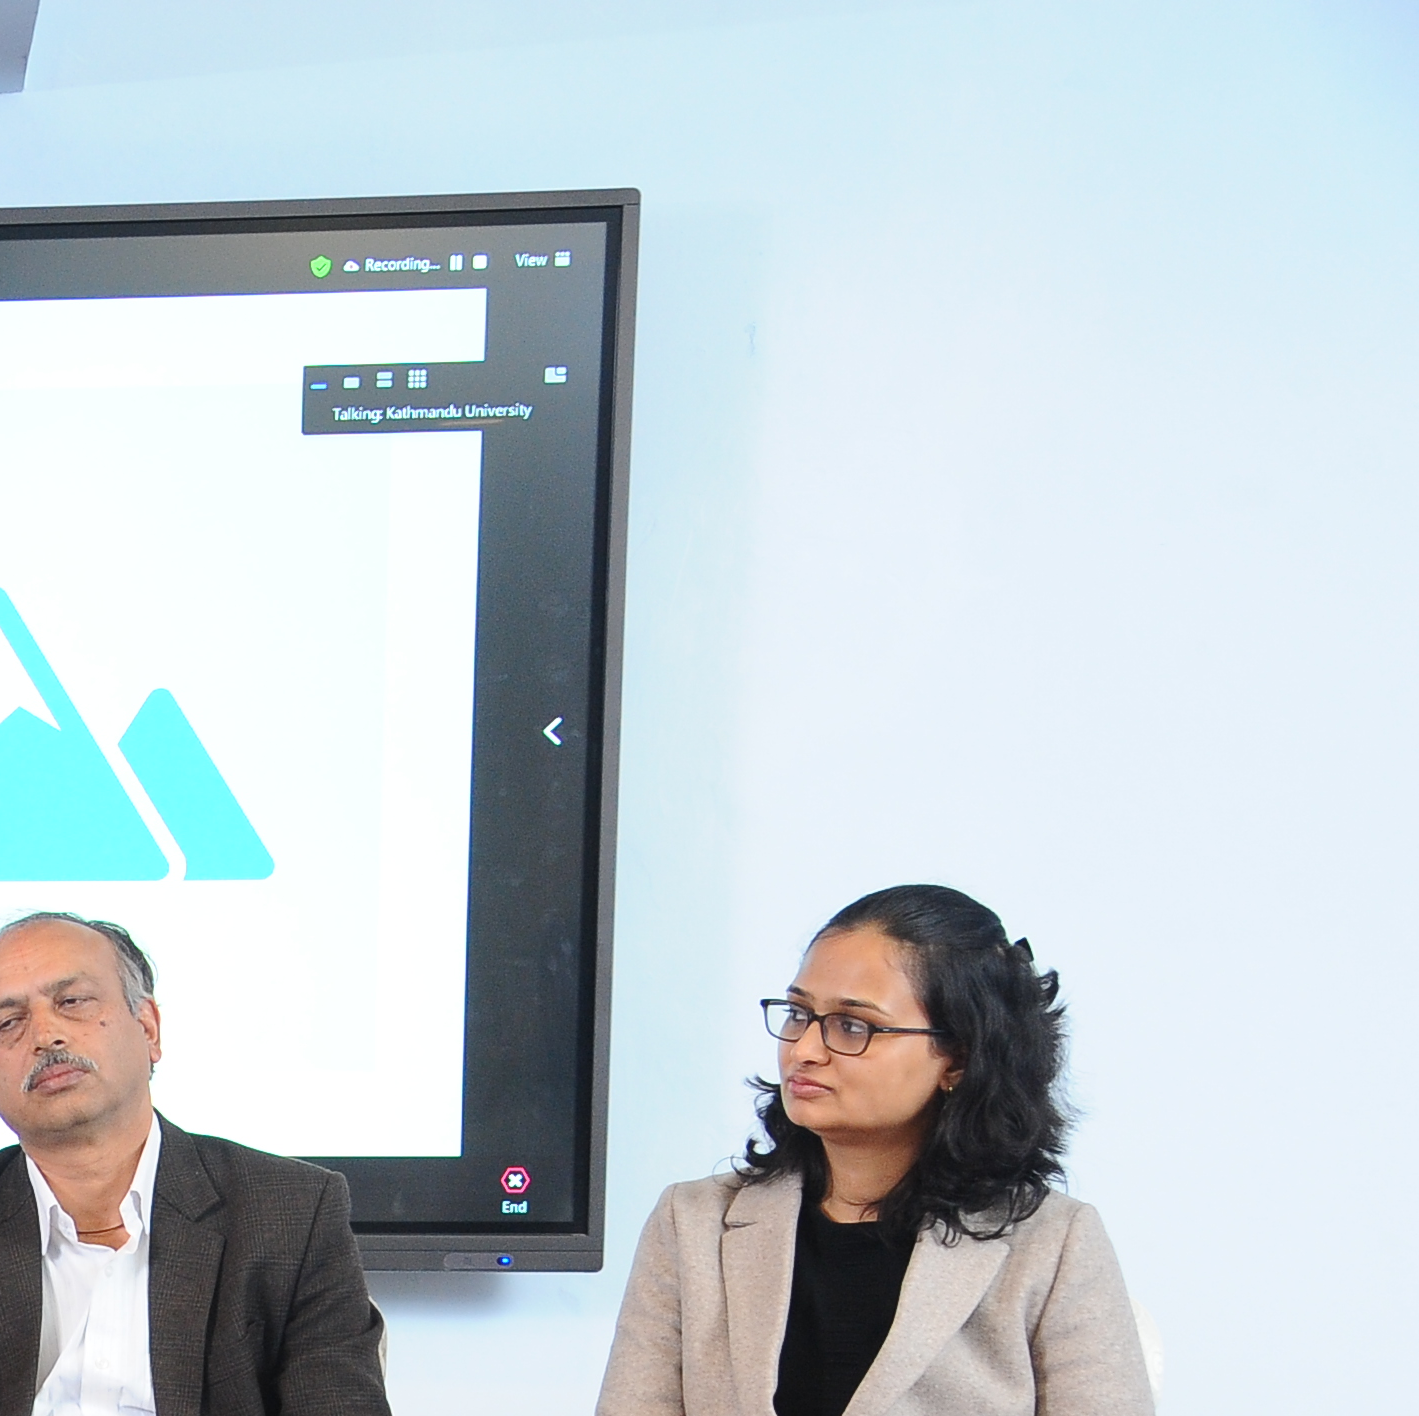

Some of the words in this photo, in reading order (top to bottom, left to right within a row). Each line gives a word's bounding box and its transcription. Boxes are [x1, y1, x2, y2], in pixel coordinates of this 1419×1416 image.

[365, 257, 441, 274] Recording...
[515, 252, 548, 267] View
[332, 406, 384, 424] Talking:
[386, 404, 462, 421] Kathmandu
[464, 402, 533, 421] University
[501, 1200, 528, 1214] End
